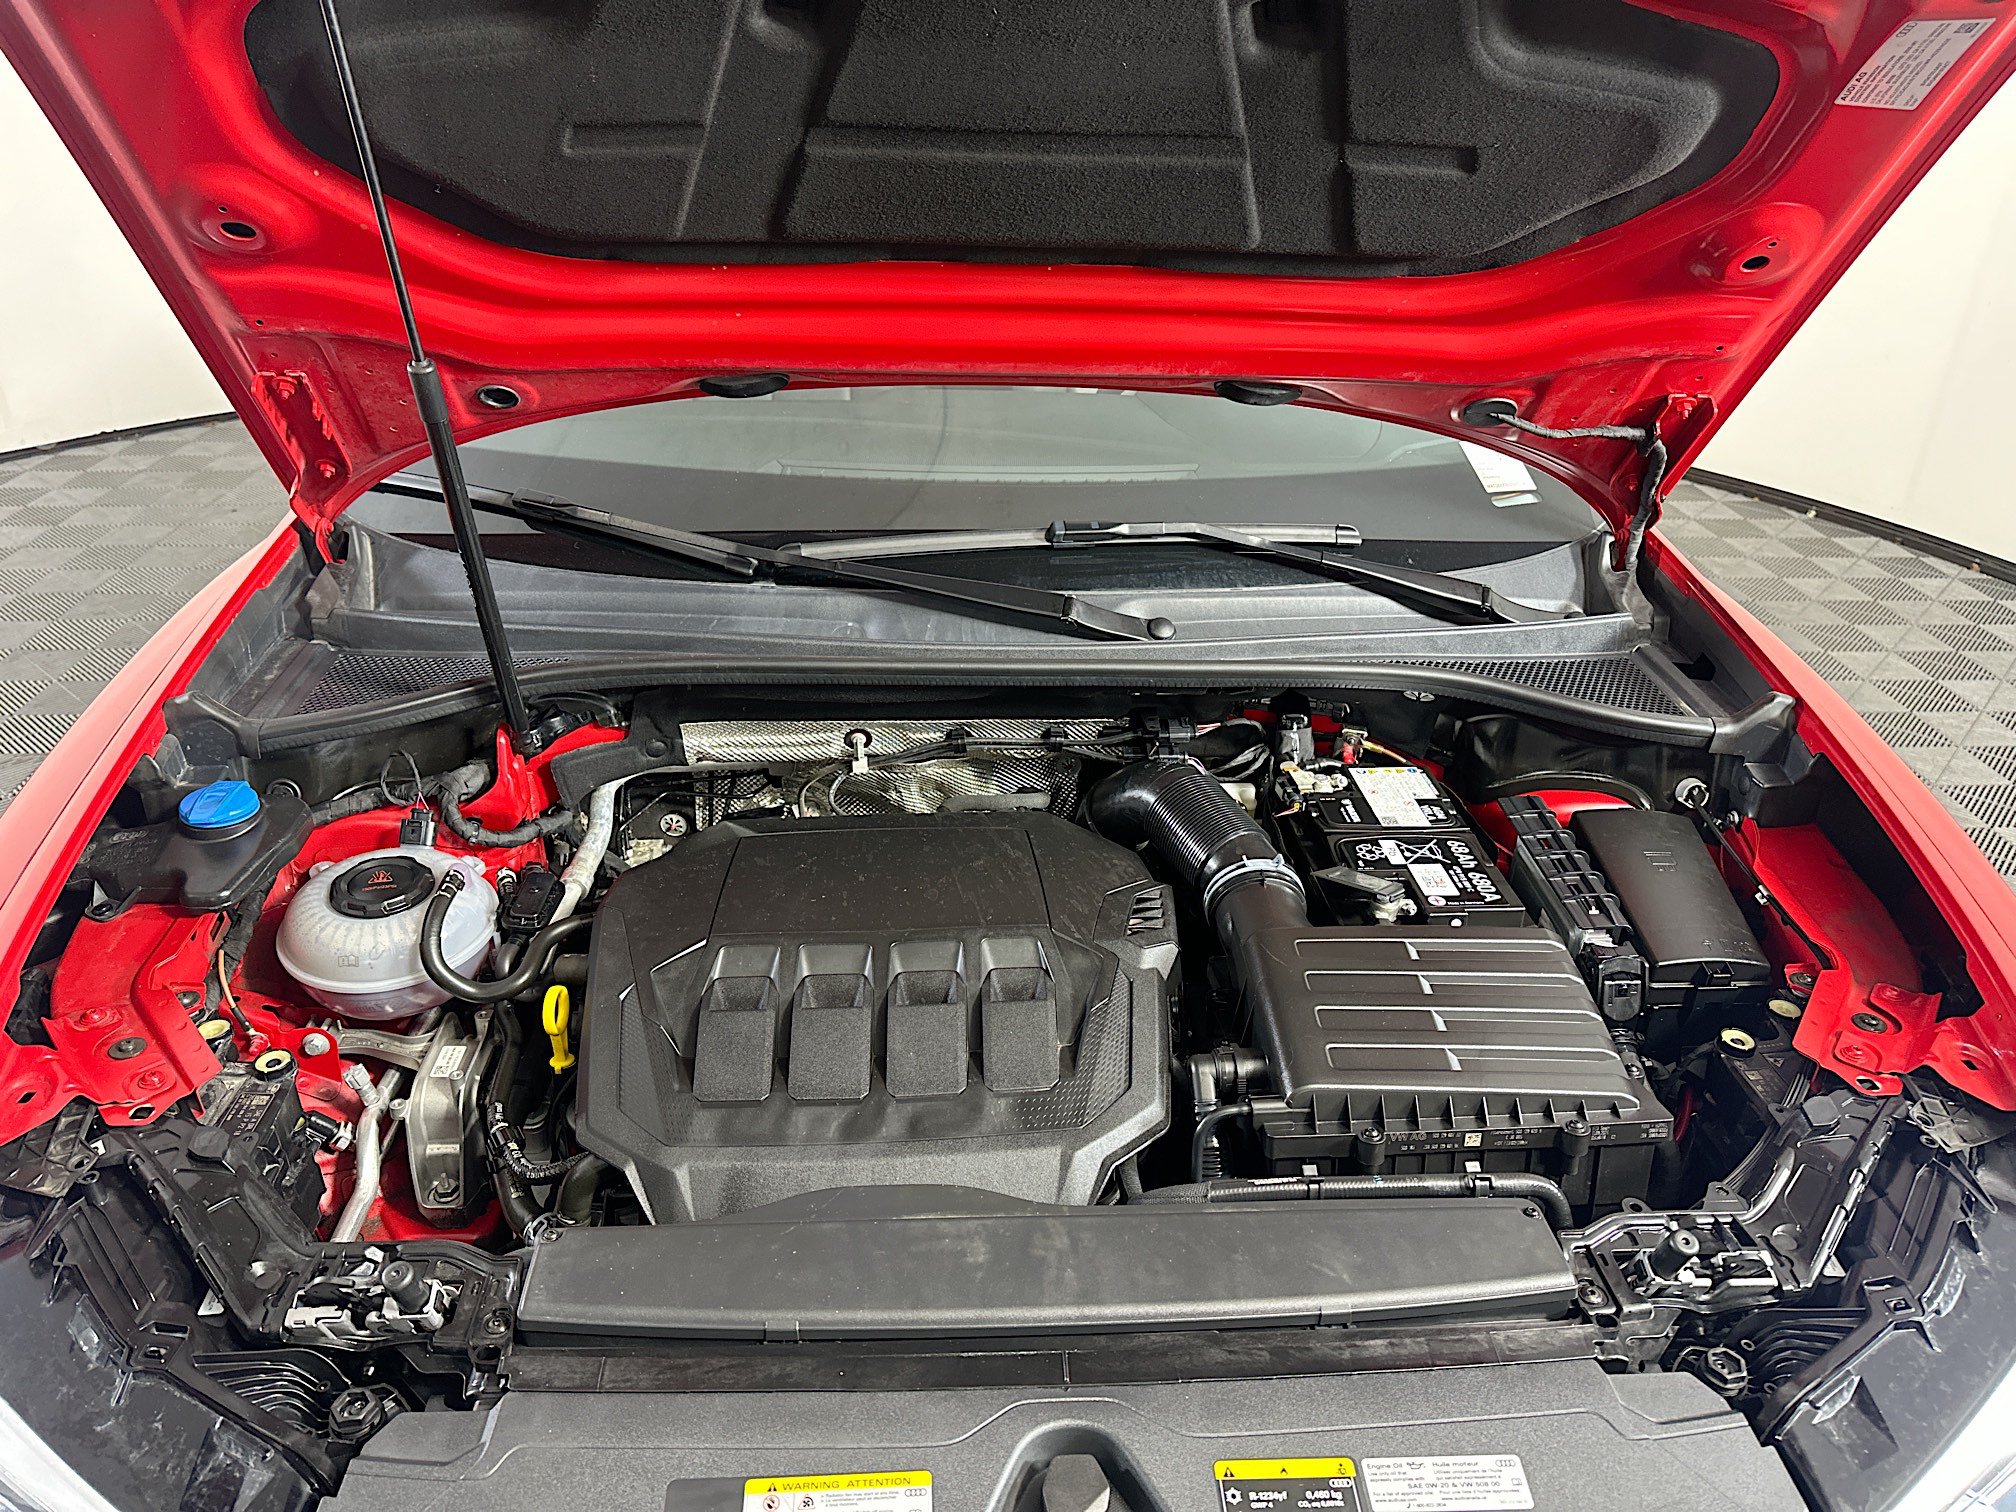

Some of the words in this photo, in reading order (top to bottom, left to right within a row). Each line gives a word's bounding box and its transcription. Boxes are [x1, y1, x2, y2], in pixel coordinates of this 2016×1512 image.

[1840, 83, 1856, 101] AUDI
[1855, 72, 1867, 84] AG
[1446, 840, 1478, 868] 68Ah
[1468, 872, 1502, 902] 680A
[1390, 1132, 1408, 1141] VW
[1410, 1132, 1427, 1141] AG
[782, 1480, 840, 1490] WARNING
[846, 1478, 911, 1488] ATTENTION
[1248, 1491, 1287, 1501] R-1234yf
